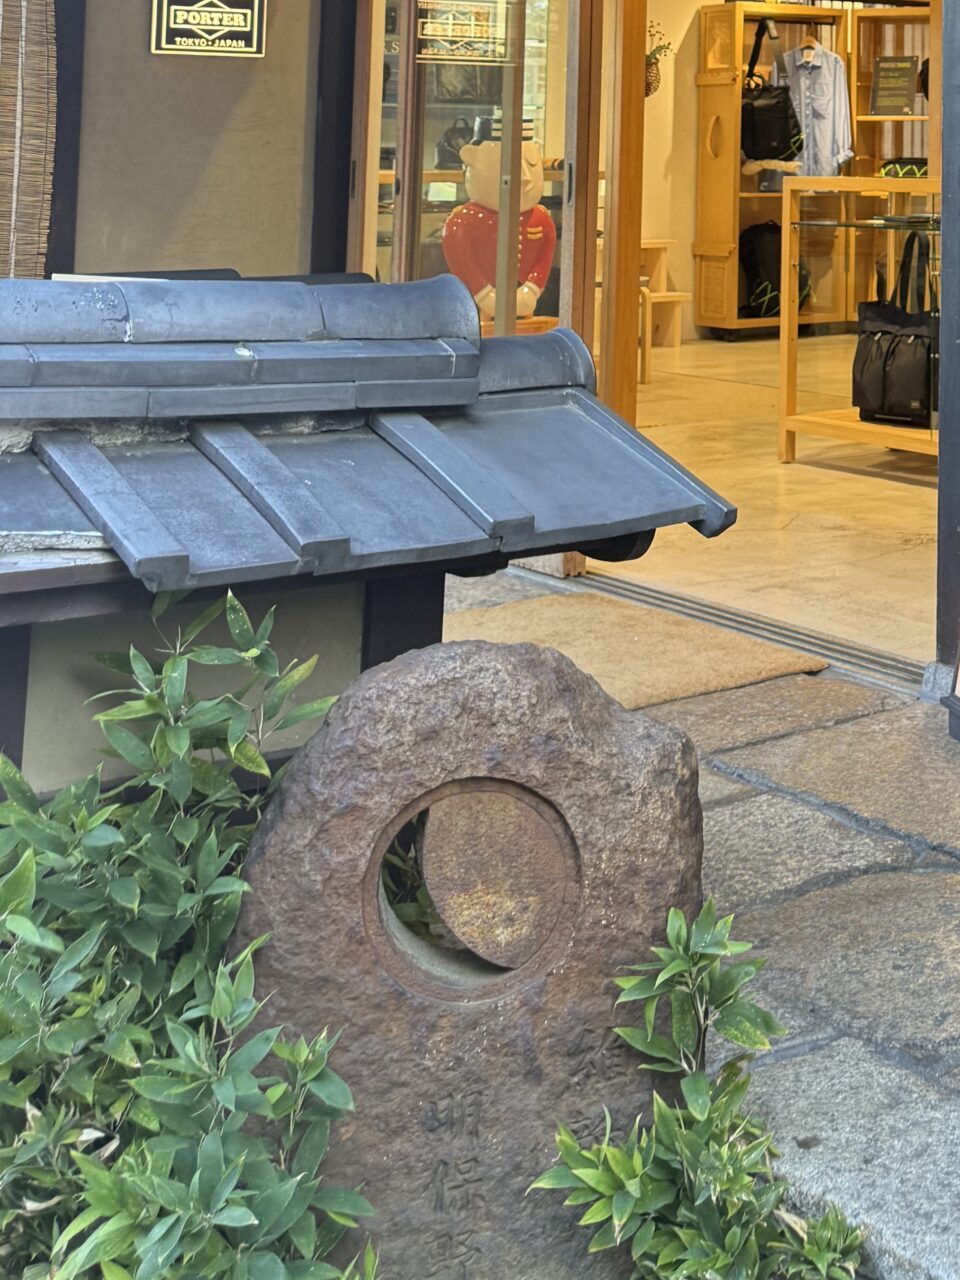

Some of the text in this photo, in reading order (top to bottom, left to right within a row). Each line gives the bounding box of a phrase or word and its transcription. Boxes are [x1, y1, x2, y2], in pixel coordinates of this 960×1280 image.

[175, 11, 246, 27] PORTER
[175, 37, 246, 49] TOKYO JAPAN
